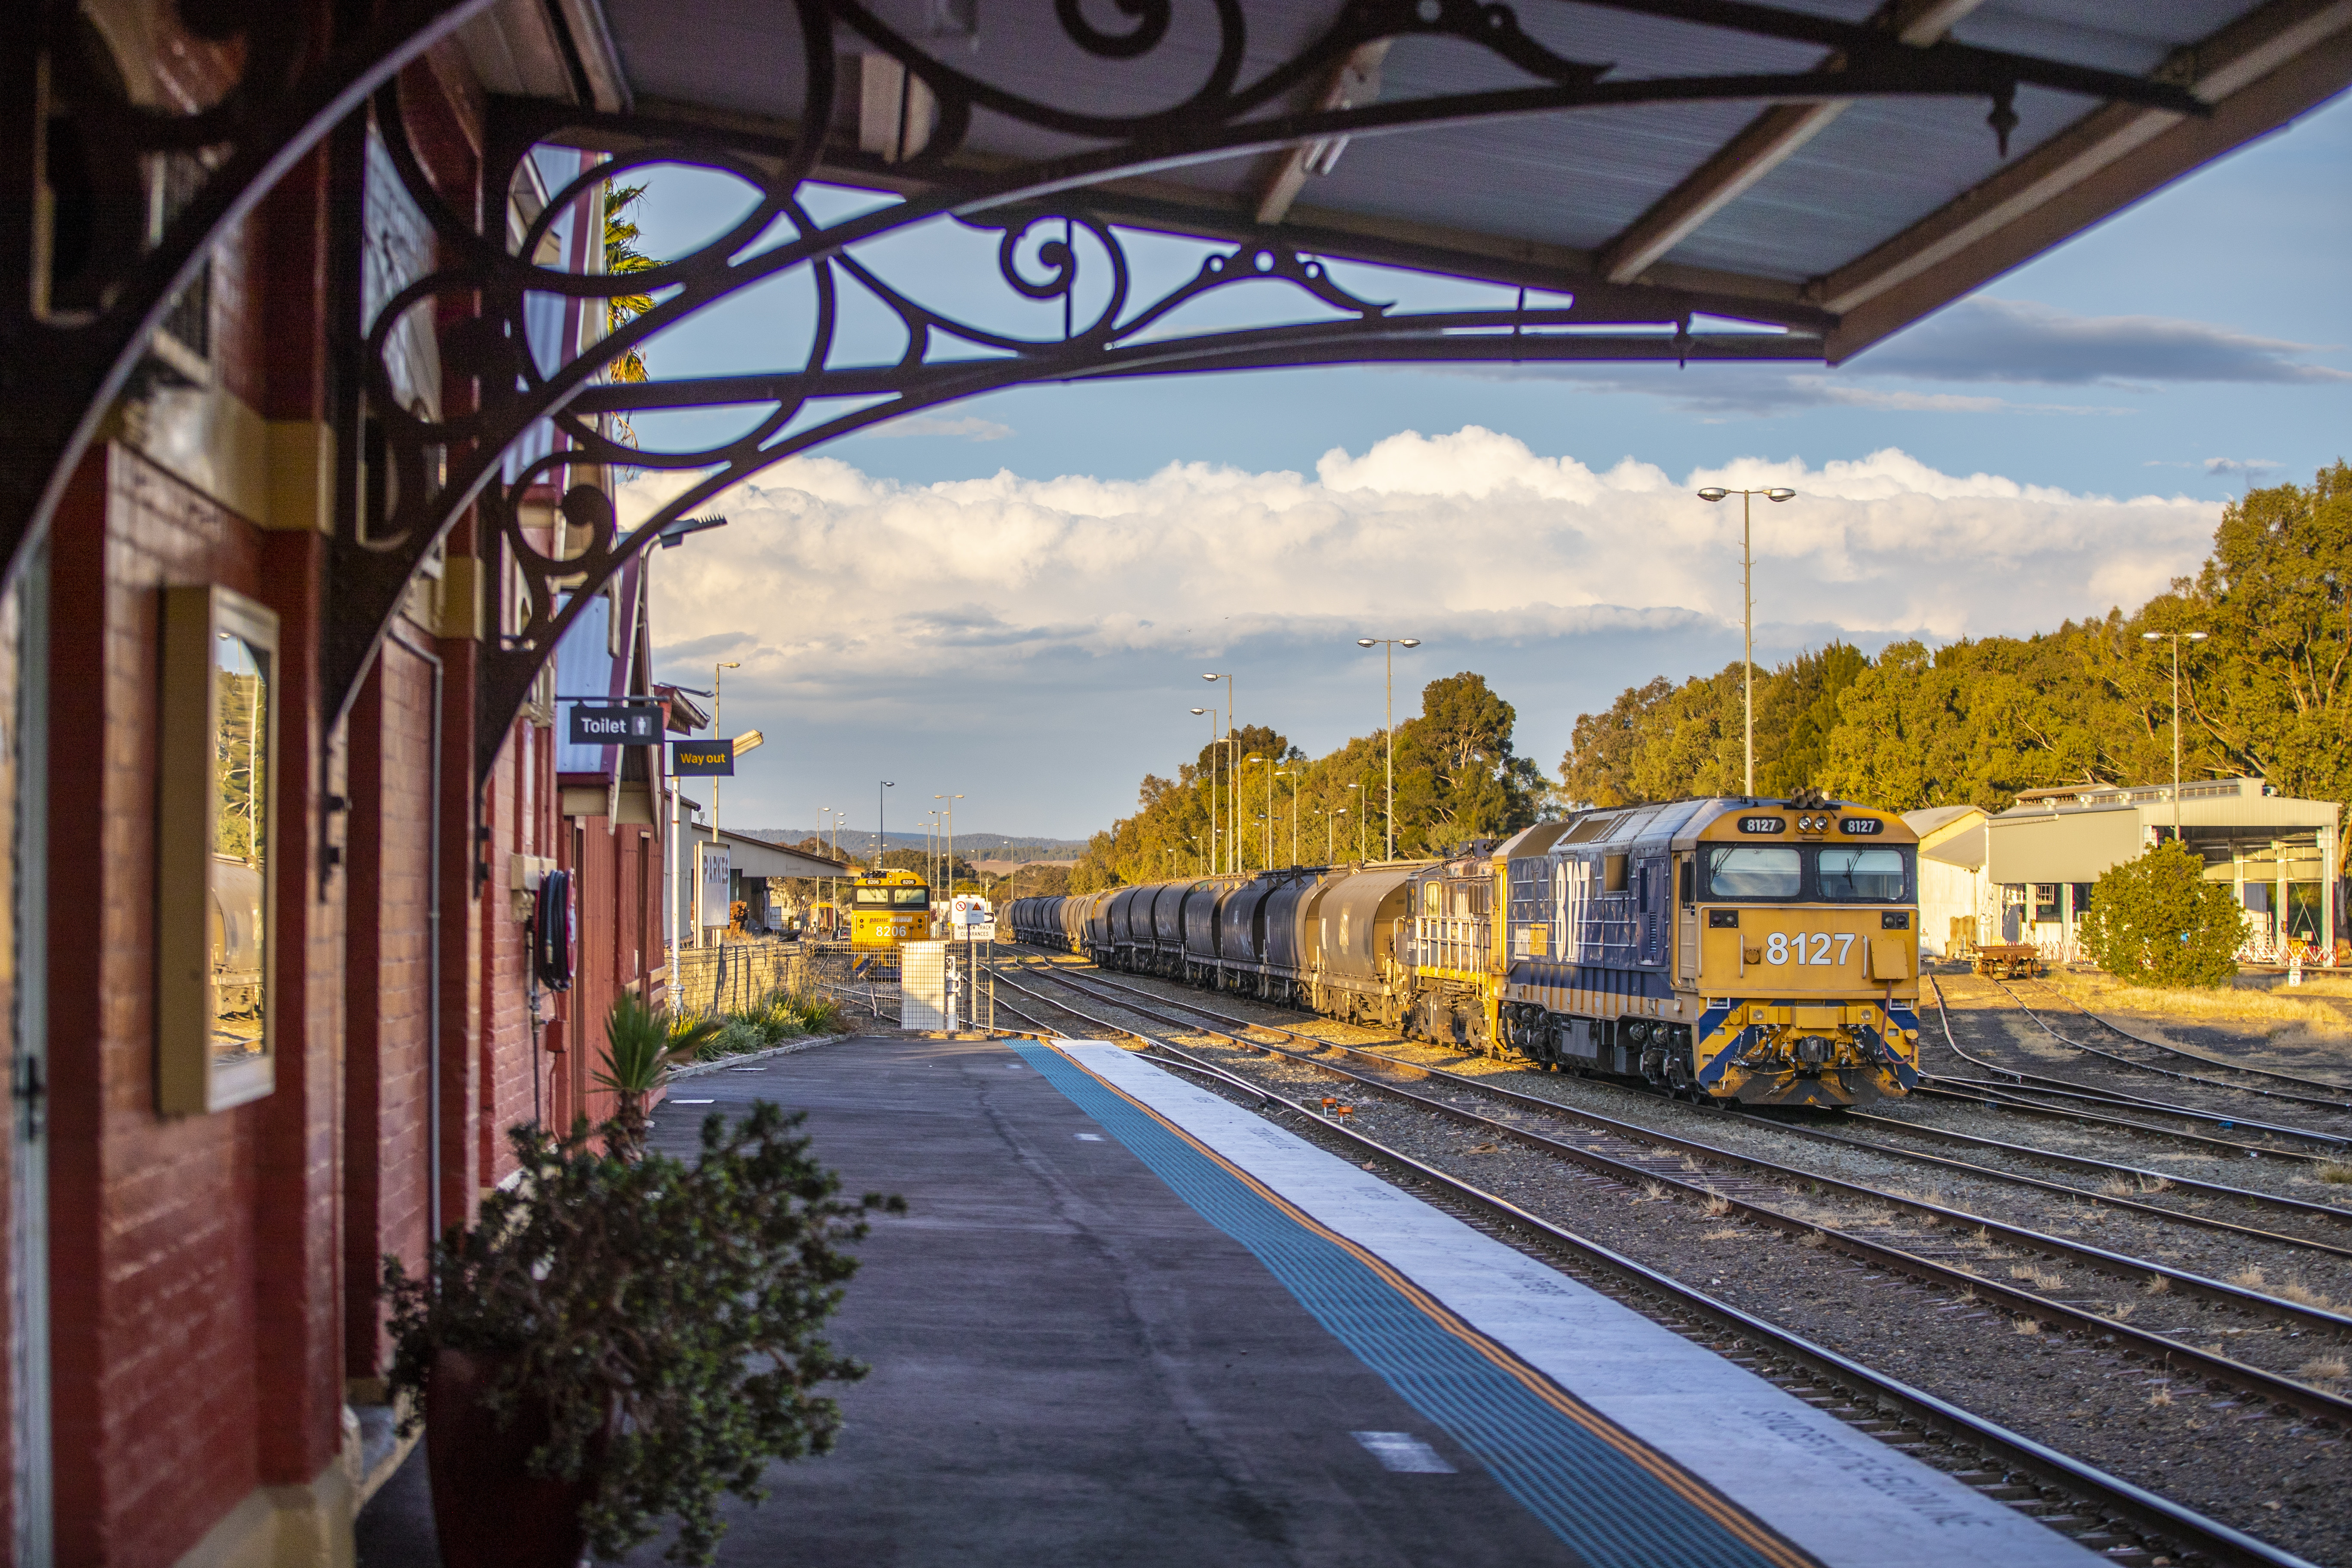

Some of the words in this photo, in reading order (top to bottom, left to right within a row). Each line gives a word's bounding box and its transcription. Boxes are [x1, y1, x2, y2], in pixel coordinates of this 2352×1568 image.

[581, 717, 626, 733] Toilet
[680, 753, 704, 766] Way
[706, 753, 726, 763] out
[1747, 819, 1776, 831] 8127
[1848, 821, 1875, 832] 8127
[704, 855, 729, 884] PARKES
[1555, 862, 1590, 963] 8127
[876, 926, 906, 937] 8206
[1766, 932, 1856, 965] 8127
